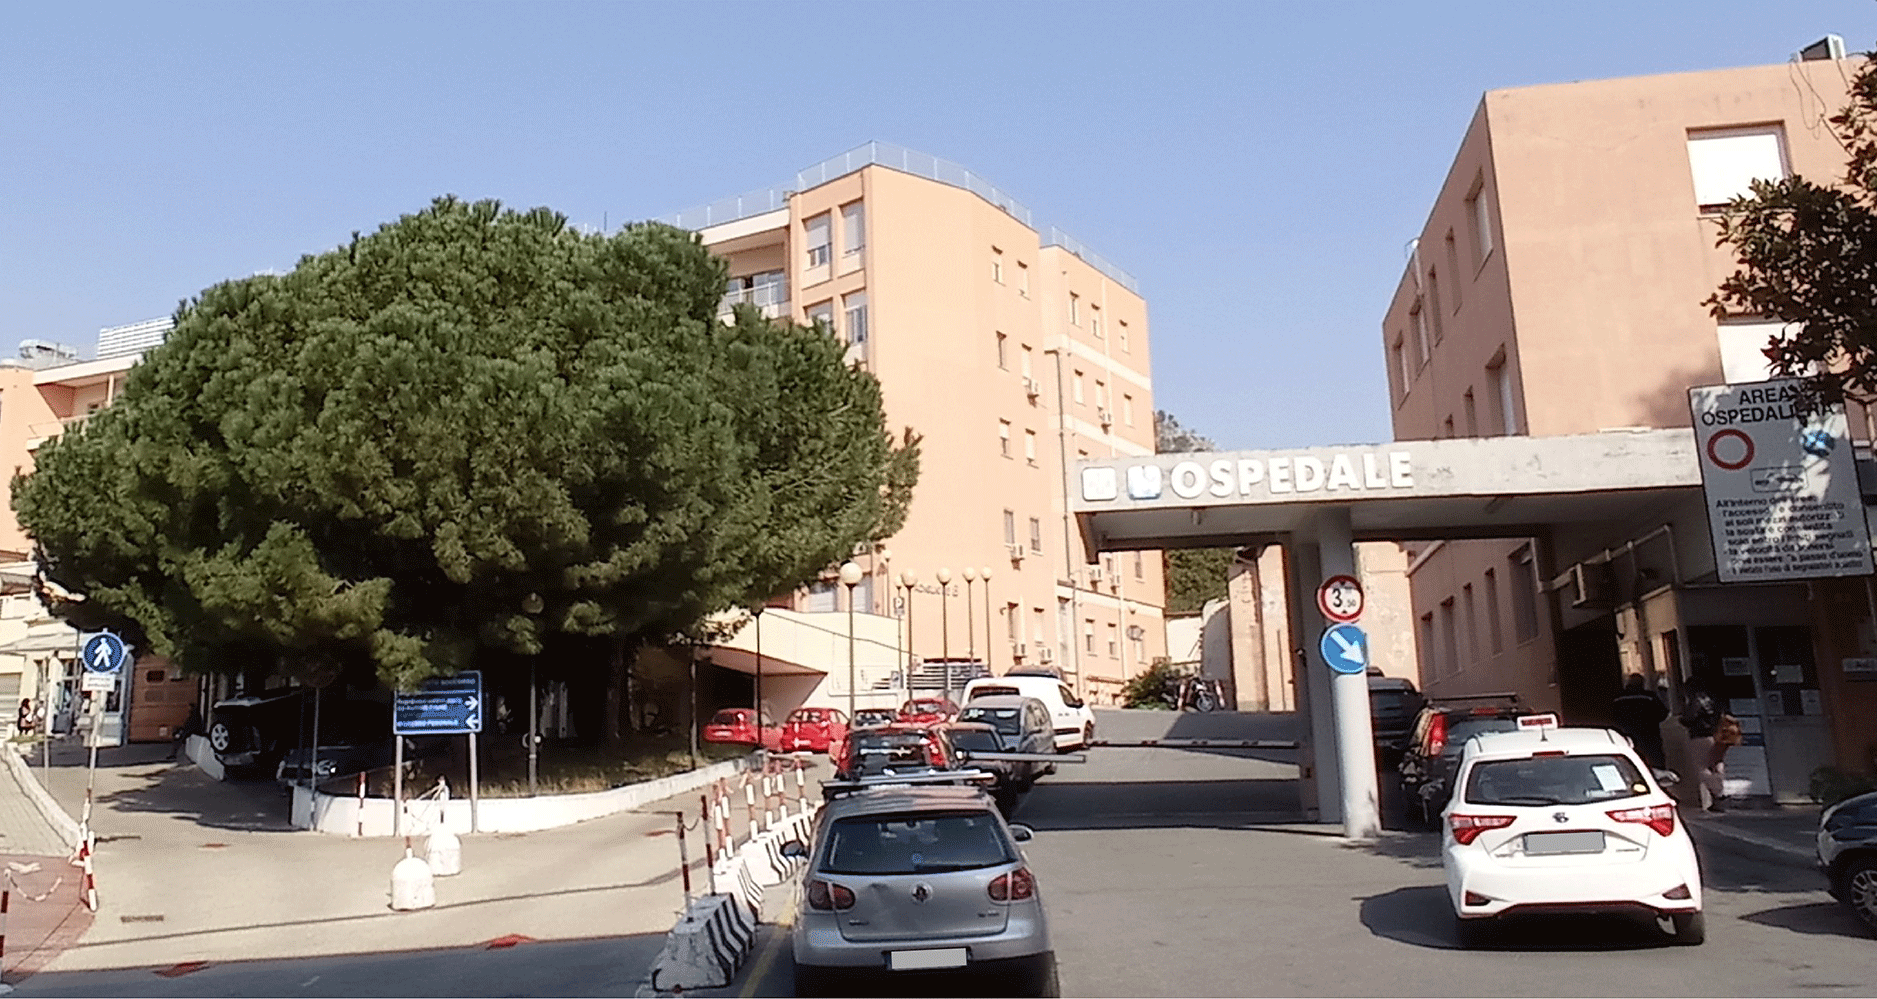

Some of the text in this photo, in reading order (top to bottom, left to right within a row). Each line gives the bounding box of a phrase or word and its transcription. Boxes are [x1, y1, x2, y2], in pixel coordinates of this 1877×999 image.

[1739, 386, 1791, 405] AREA
[1702, 402, 1834, 426] OSPEDALIRA
[1170, 451, 1415, 498] OSPEDALE
